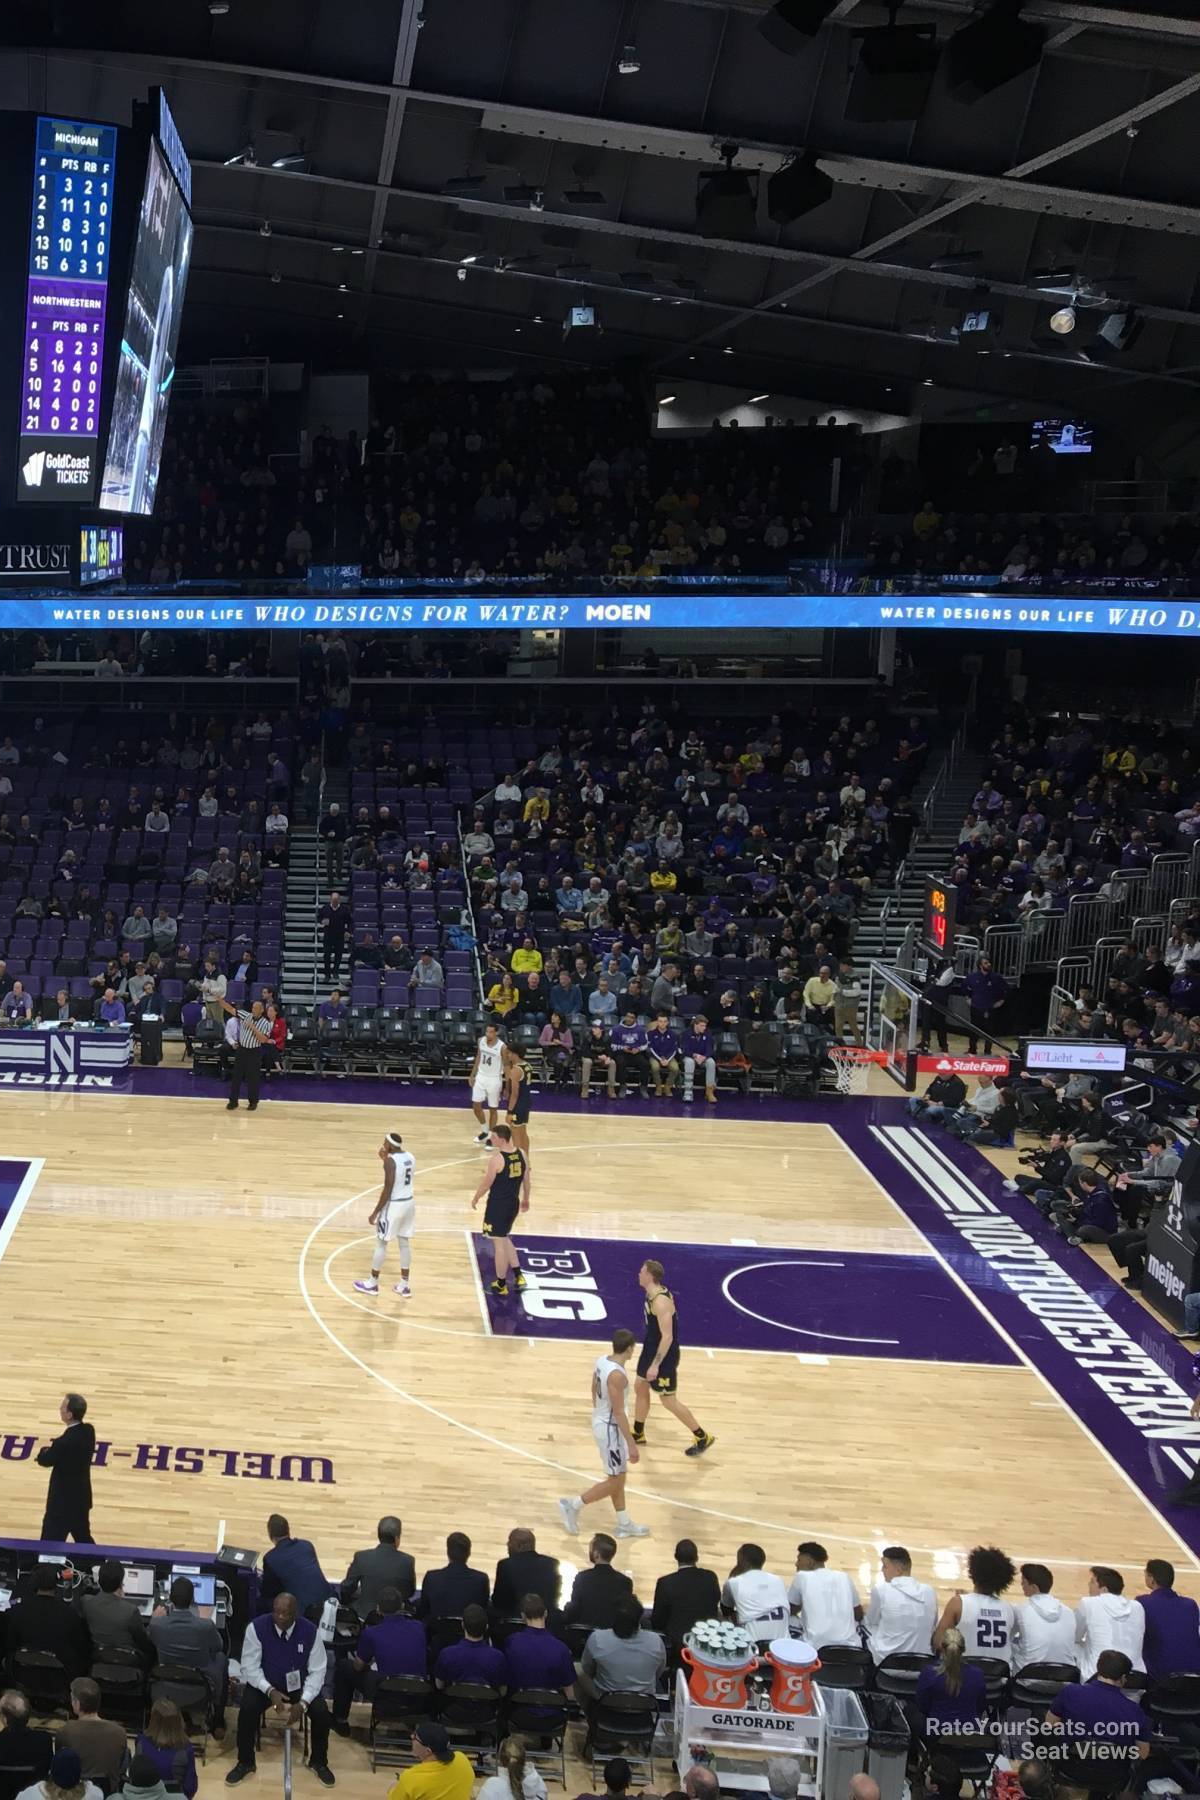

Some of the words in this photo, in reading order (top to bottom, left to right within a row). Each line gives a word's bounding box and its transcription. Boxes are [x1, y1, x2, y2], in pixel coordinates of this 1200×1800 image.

[55, 132, 98, 146] MICHIGAN
[62, 158, 79, 172] PTS
[84, 162, 98, 172] RB
[103, 164, 110, 174] F
[39, 175, 46, 189] 1
[64, 178, 72, 192] 3
[84, 180, 92, 194] 2
[101, 182, 108, 196] 1
[38, 196, 46, 210] 2
[61, 198, 74, 212] 11
[84, 200, 90, 214] 1
[100, 202, 108, 216] 0
[37, 216, 45, 230] 3
[62, 218, 71, 232] 8
[82, 220, 90, 234] 3
[98, 222, 105, 236] 1
[36, 236, 50, 250] 13
[58, 238, 72, 252] 10
[81, 240, 88, 254] 1
[97, 242, 104, 256] 0
[34, 256, 48, 270] 15
[60, 258, 68, 272] 6
[79, 260, 87, 274] 3
[96, 262, 102, 275] 1
[33, 295, 101, 309] NORTHWESTERN
[52, 320, 69, 332] PTS
[74, 322, 87, 333] RB
[94, 324, 100, 334] F
[30, 338, 39, 352] 4
[56, 340, 64, 354] 8
[74, 341, 82, 355] 2
[91, 342, 98, 356] 3
[30, 358, 38, 372] 5
[52, 360, 64, 373] 16
[72, 361, 82, 374] 4
[90, 361, 97, 374] 0
[28, 378, 42, 391] 10
[53, 378, 61, 392] 2
[72, 380, 80, 393] 0
[88, 380, 96, 394] 0
[27, 397, 40, 410] 14
[52, 398, 60, 411] 4
[72, 398, 80, 412] 0
[88, 399, 94, 412] 2
[26, 416, 40, 430] 21
[51, 416, 60, 430] 0
[70, 417, 78, 430] 2
[86, 418, 94, 431] 0
[46, 454, 90, 470] GoldCoast
[56, 470, 90, 484] TICKETS
[53, 609, 101, 620] WATER
[108, 609, 170, 620] DESIGNS
[176, 609, 205, 620] OUR
[211, 609, 244, 620] LIFE
[254, 606, 306, 622] WHO
[314, 606, 413, 622] DESIGNS
[422, 605, 468, 622] FOR
[479, 604, 570, 622] WATER?
[586, 604, 651, 621] MOEN
[880, 607, 936, 619] WATER
[943, 608, 1012, 620] DESIGNS
[1018, 609, 1050, 622] OUR
[1058, 610, 1095, 623] LIFE
[1107, 608, 1167, 626] WHO
[936, 915, 946, 946] 4
[50, 1034, 74, 1073] N
[482, 1054, 492, 1066] 14
[404, 1168, 412, 1186] 5
[378, 1222, 386, 1235] N
[1148, 1253, 1186, 1302] meijer
[944, 1213, 1200, 1440] NORTHWESTERN
[610, 1450, 622, 1466] N
[977, 1618, 1008, 1648] 25
[716, 1678, 732, 1694] G
[786, 1676, 802, 1691] G
[712, 1714, 795, 1732] GATORADE
